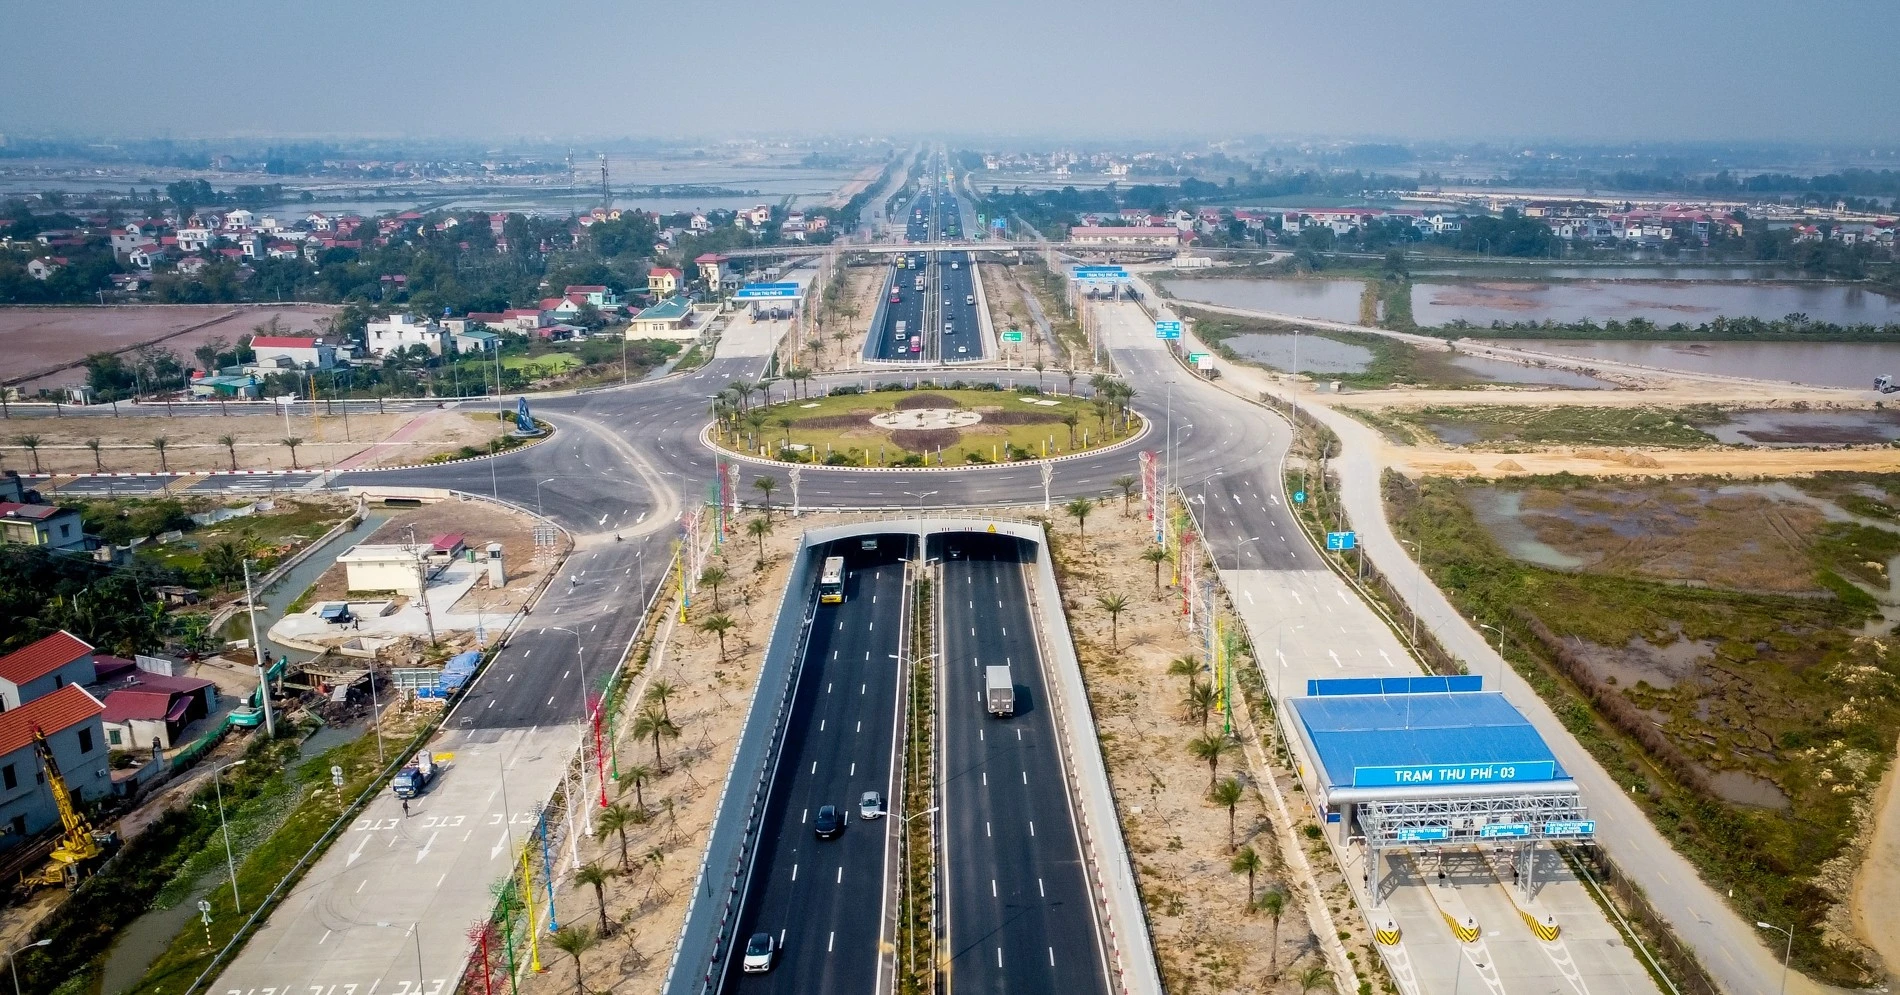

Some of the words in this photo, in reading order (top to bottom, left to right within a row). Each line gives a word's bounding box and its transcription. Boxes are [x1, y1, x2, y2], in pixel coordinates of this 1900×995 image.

[1394, 769, 1433, 783] TRẠM
[1438, 768, 1466, 781] THU
[354, 818, 400, 831] ETC
[422, 815, 466, 828] ETC
